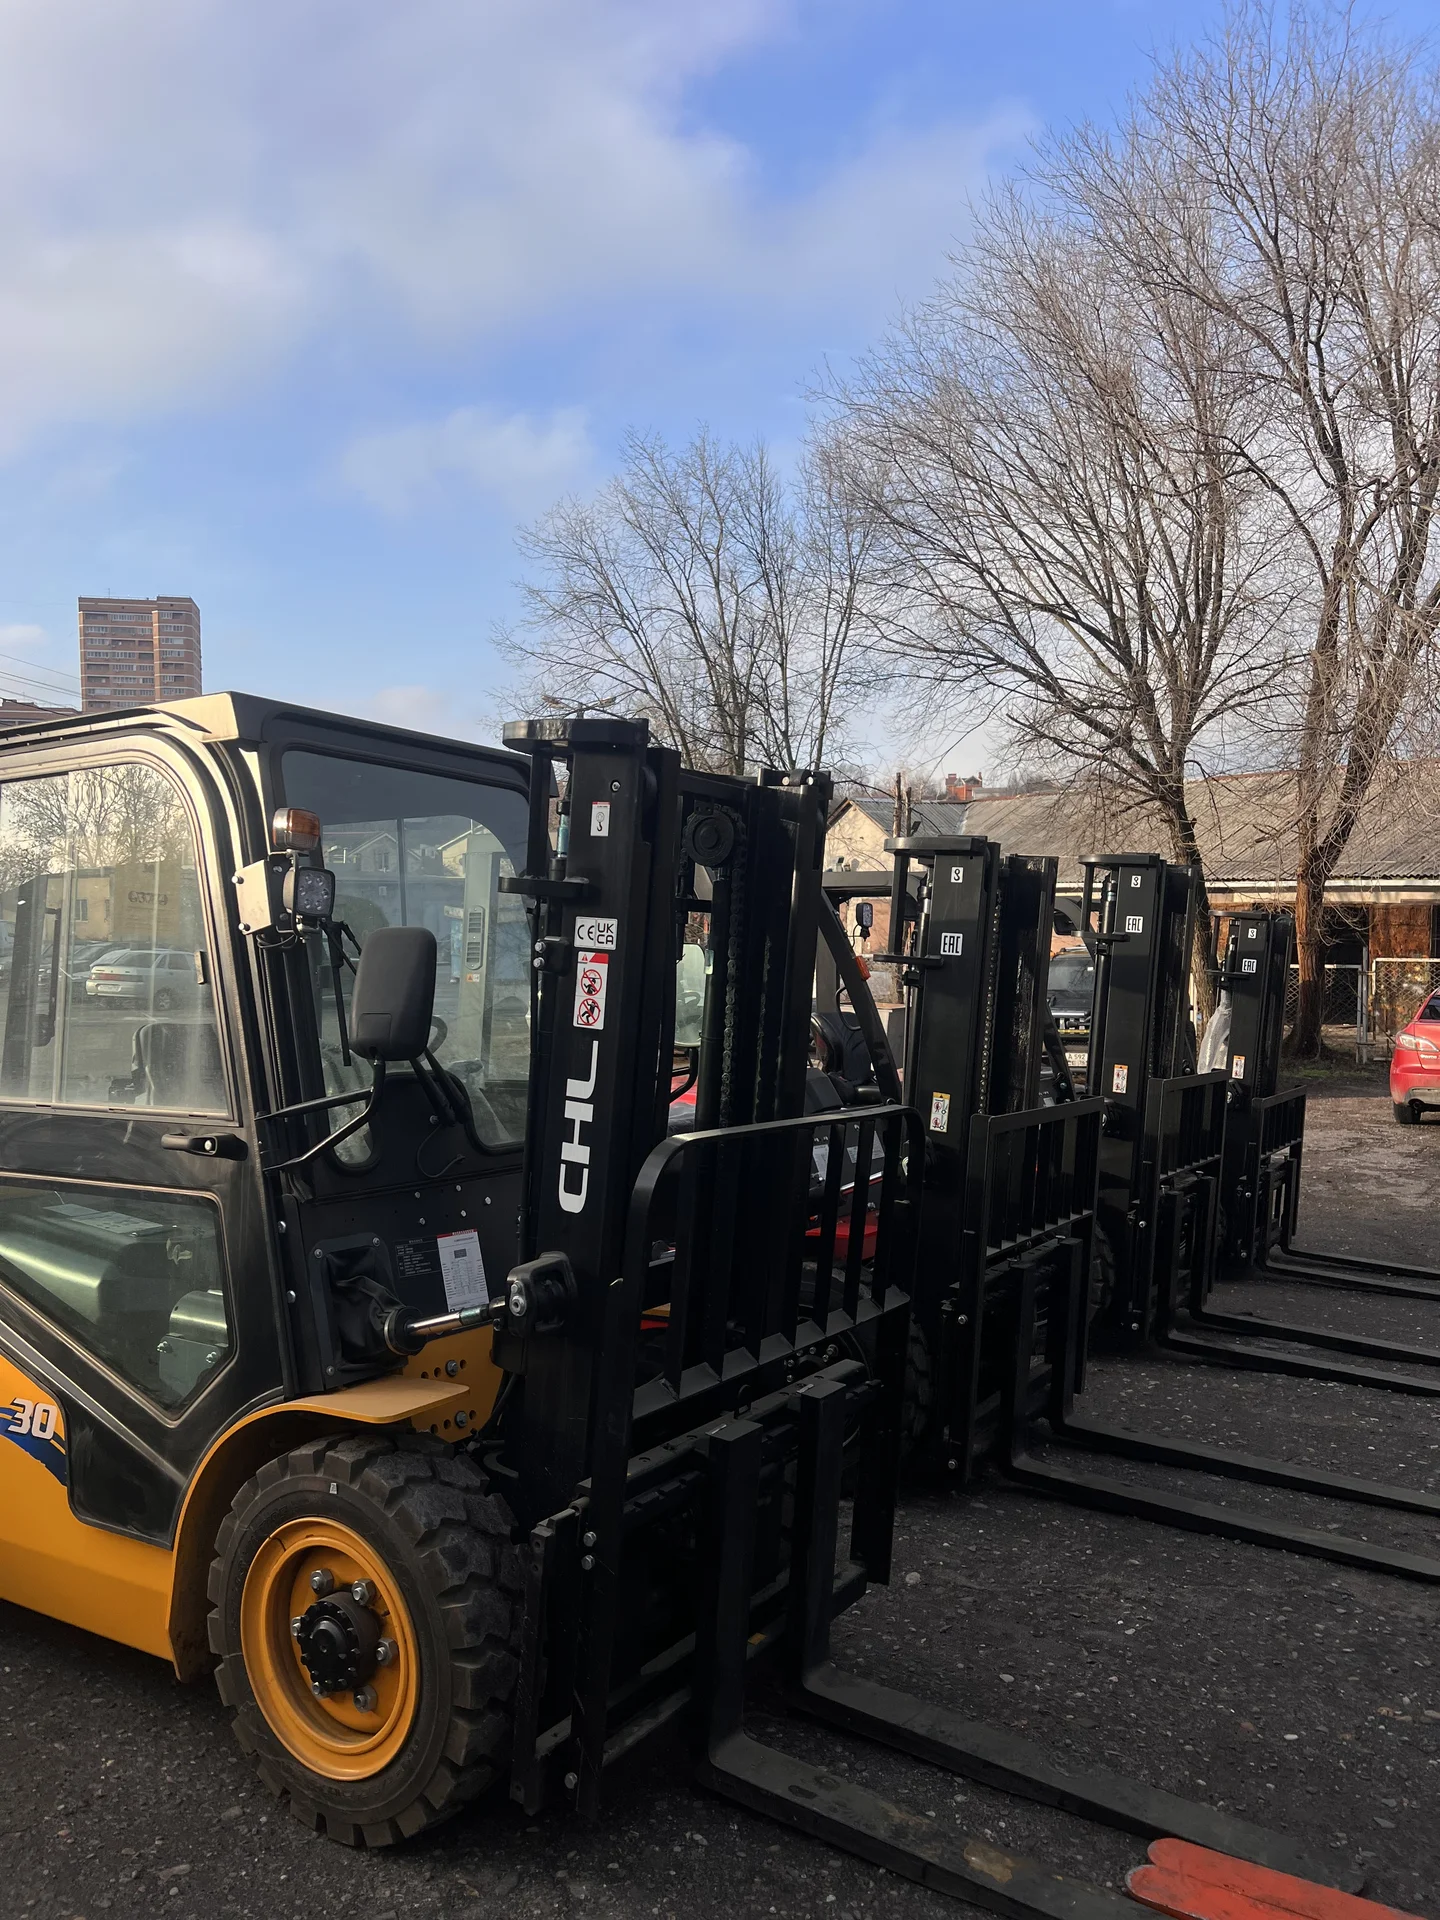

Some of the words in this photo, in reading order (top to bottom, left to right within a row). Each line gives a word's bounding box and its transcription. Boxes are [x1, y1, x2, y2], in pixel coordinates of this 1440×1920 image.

[597, 922, 615, 934] UK
[1127, 917, 1141, 931] EAC
[577, 924, 595, 941] CE
[596, 934, 614, 945] CA
[942, 935, 961, 954] EAC
[1243, 960, 1256, 972] EAC
[558, 1040, 599, 1214] CHL
[7, 1397, 58, 1440] 30
